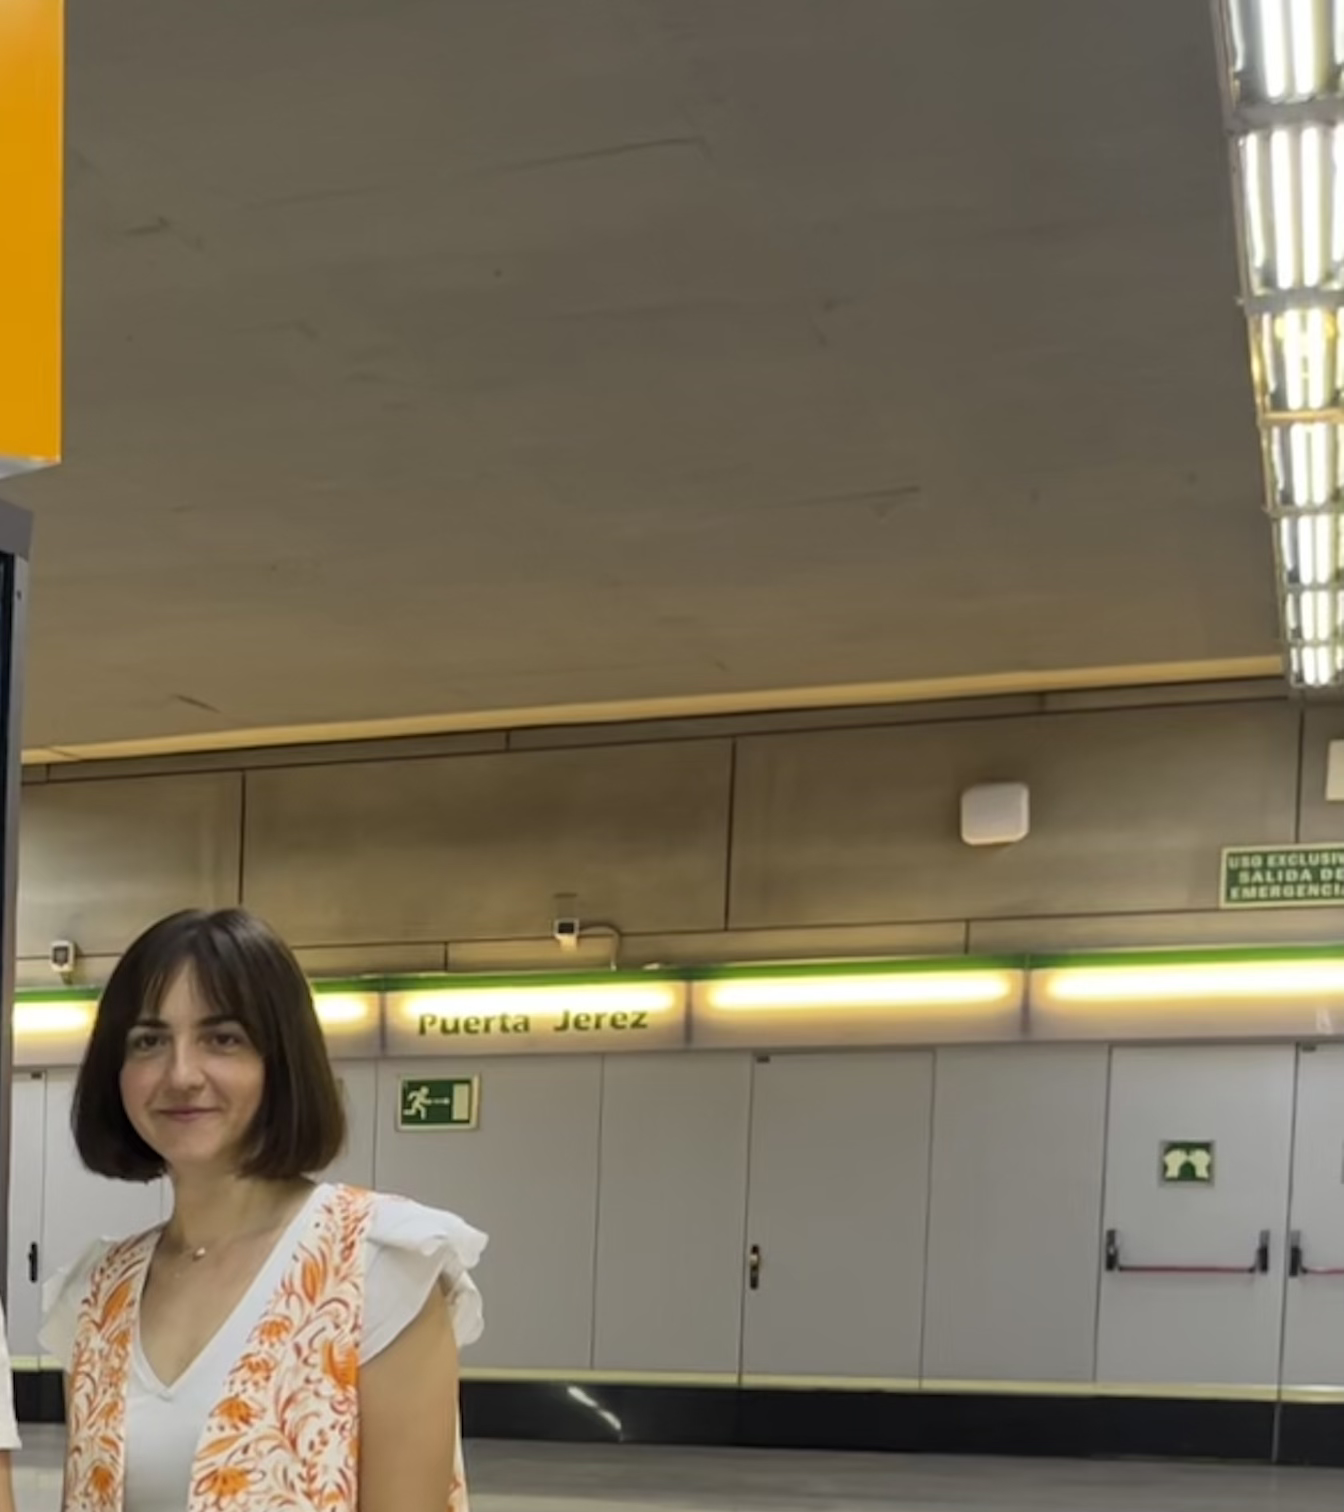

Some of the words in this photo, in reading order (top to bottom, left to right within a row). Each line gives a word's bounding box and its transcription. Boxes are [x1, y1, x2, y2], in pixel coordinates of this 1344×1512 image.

[1228, 855, 1263, 869] USO
[1267, 851, 1344, 868] EXCLUSIV
[1238, 868, 1313, 885] SALIDA
[1229, 883, 1344, 900] EMERGENCI
[418, 1013, 531, 1036] Puerta
[552, 1008, 649, 1034] Jerez
